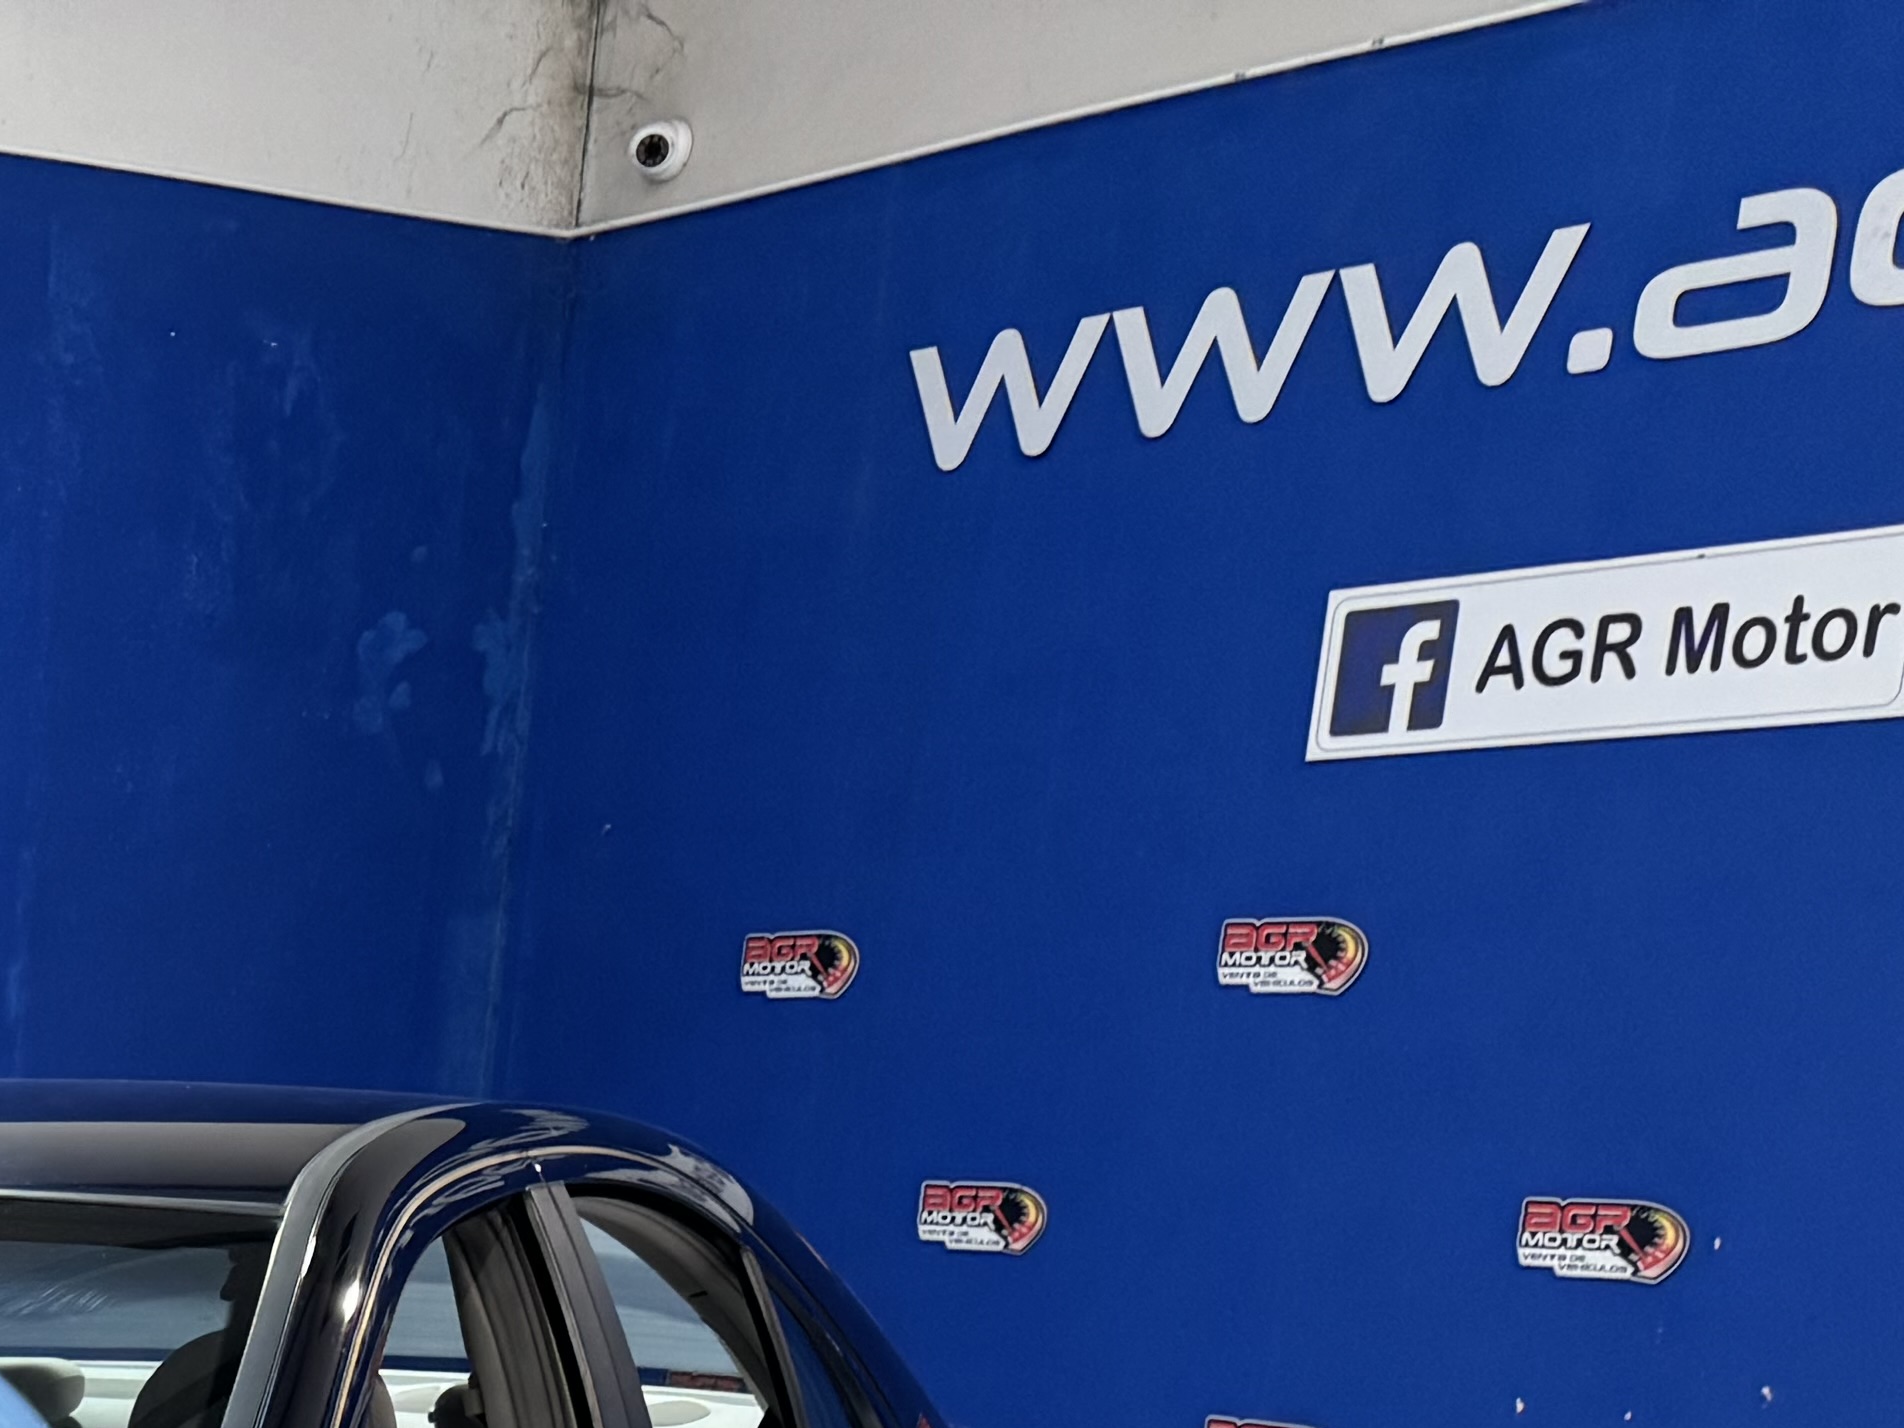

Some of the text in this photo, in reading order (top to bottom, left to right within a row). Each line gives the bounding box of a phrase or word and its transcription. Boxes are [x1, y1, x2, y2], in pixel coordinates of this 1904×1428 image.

[1476, 613, 1643, 693] AGR
[1665, 595, 1901, 676] Motor
[743, 960, 812, 976] MOTOR
[1221, 951, 1308, 969] MOTOR
[921, 1210, 996, 1230] MOTOR
[1521, 1232, 1621, 1254] MOTOR
